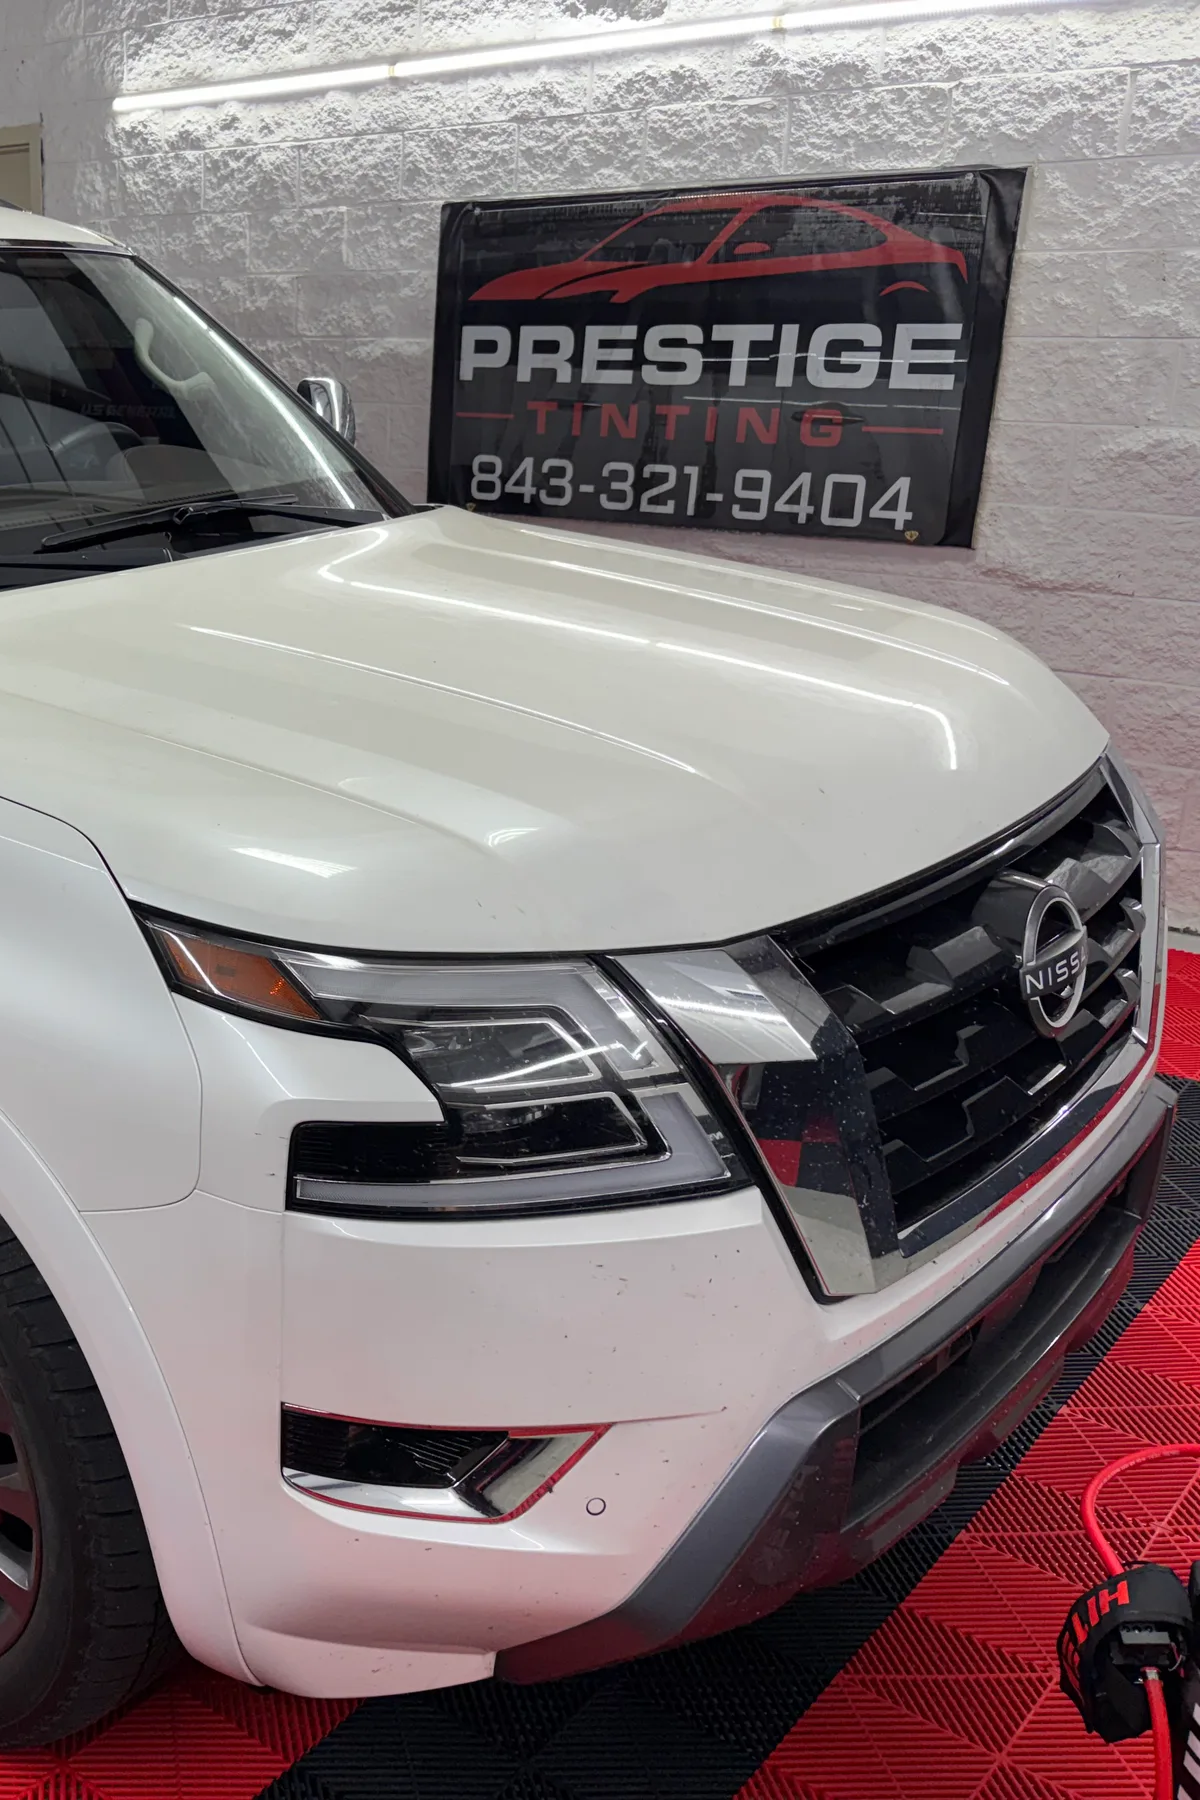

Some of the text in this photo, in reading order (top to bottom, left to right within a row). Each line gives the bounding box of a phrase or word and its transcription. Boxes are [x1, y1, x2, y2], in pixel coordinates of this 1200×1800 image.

[459, 323, 963, 391] PRESTIGE
[526, 401, 844, 448] TINTING
[470, 454, 913, 531] 843-321-9404
